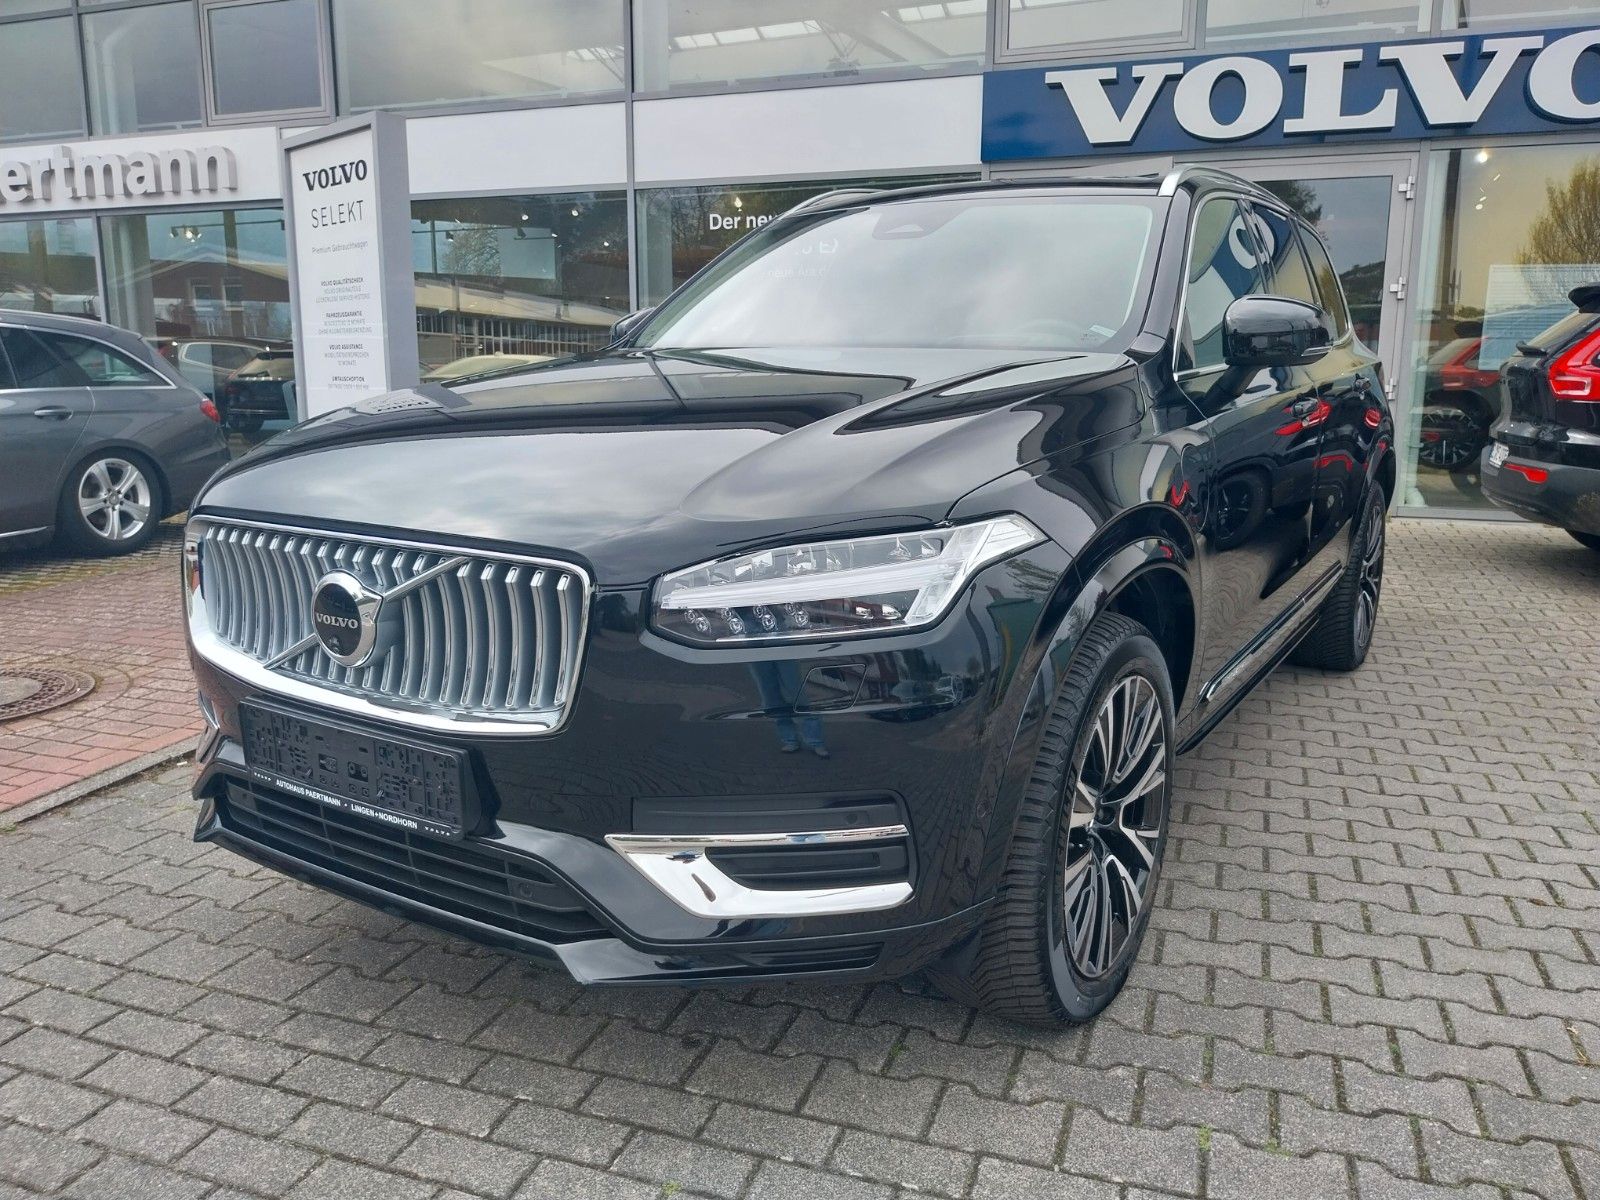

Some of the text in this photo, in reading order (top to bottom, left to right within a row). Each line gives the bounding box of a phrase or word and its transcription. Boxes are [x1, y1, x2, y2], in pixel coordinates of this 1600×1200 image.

[1045, 30, 1600, 144] VOLVO
[302, 159, 367, 191] VOLVO
[311, 200, 363, 228] SELEKT
[709, 213, 741, 230] Der
[315, 612, 359, 629] VOLVO
[276, 779, 305, 795] AUTOHAUS
[305, 789, 341, 806] PAERTMANN
[351, 803, 418, 830] LINGEN+NORDHORN
